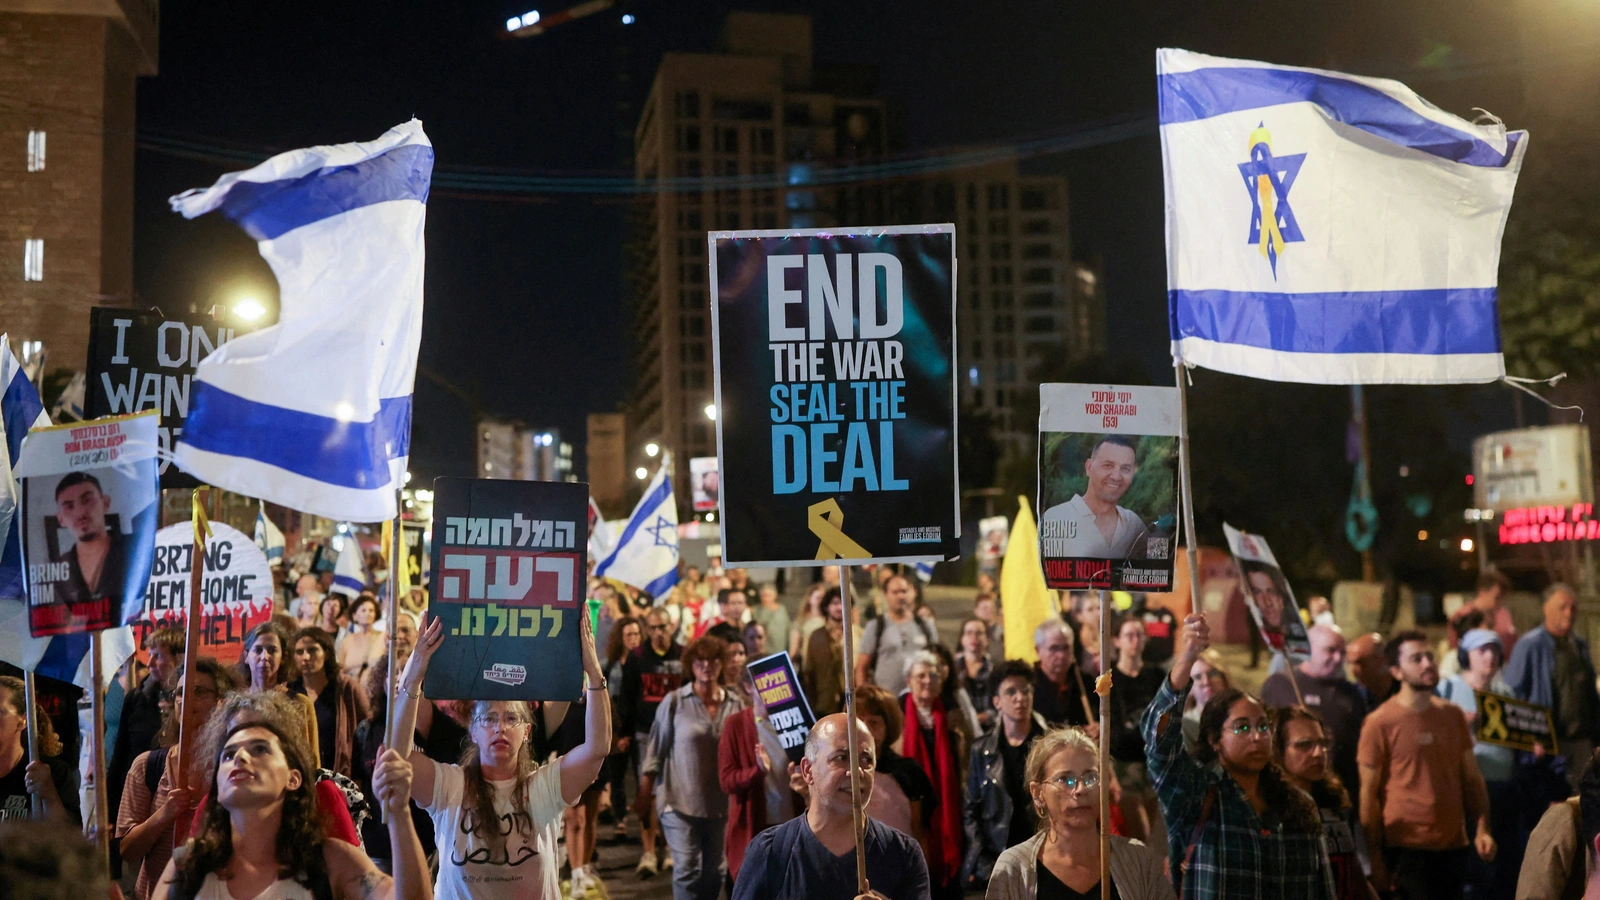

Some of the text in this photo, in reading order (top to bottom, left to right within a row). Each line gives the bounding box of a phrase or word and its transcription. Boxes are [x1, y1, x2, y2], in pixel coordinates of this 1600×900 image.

[766, 252, 904, 342] END
[111, 318, 235, 368] I ON
[768, 340, 905, 382] THE WAR
[100, 367, 196, 419] WAN
[769, 380, 907, 423] SEAL THE
[1091, 391, 1132, 404] יוסי שרעבי
[1085, 403, 1137, 416] YOSI SHARABI
[1102, 416, 1118, 429] (53)
[771, 420, 910, 495] DEAL
[445, 512, 576, 548] המלחמה
[899, 532, 941, 541] FAMILIES FORUM
[1044, 520, 1077, 539] BRING
[152, 540, 233, 577] BRING
[1044, 539, 1064, 558] HIM
[29, 561, 70, 584] BRING
[443, 554, 575, 602] רעה
[1044, 560, 1111, 580] HOME NOW!
[1122, 574, 1169, 585] FAMILIES FORUM
[30, 583, 55, 606] HIM
[144, 574, 257, 610] HEM HOME
[451, 603, 563, 638] לכולנו.
[777, 725, 809, 749] למלח
